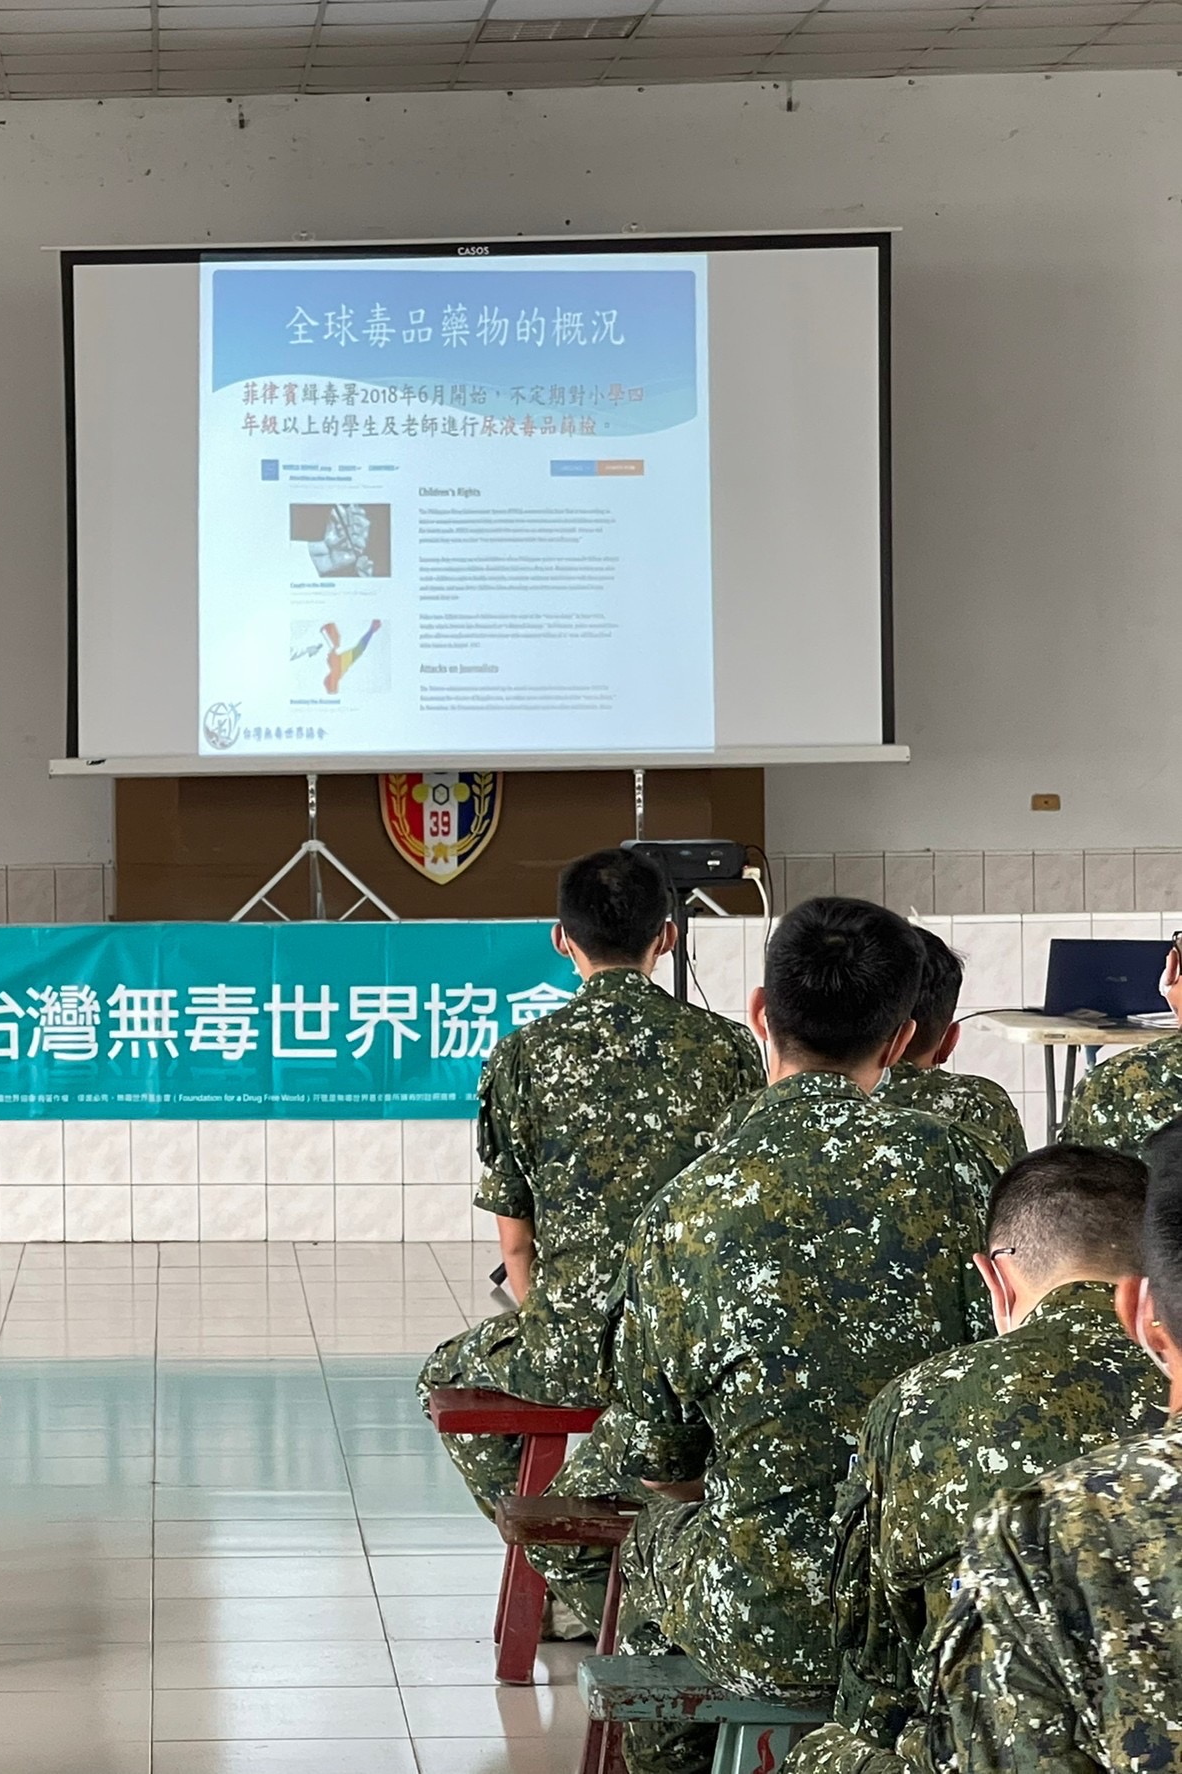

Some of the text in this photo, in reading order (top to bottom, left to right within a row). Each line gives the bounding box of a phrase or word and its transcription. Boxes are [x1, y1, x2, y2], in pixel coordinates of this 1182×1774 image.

[457, 246, 490, 256] CASOS
[285, 301, 625, 349] 全球毒品藥物的概況
[457, 487, 481, 499] Rights
[419, 664, 499, 674] Attacks on Journalists
[429, 811, 451, 837] 39
[243, 1094, 262, 1104] Drug
